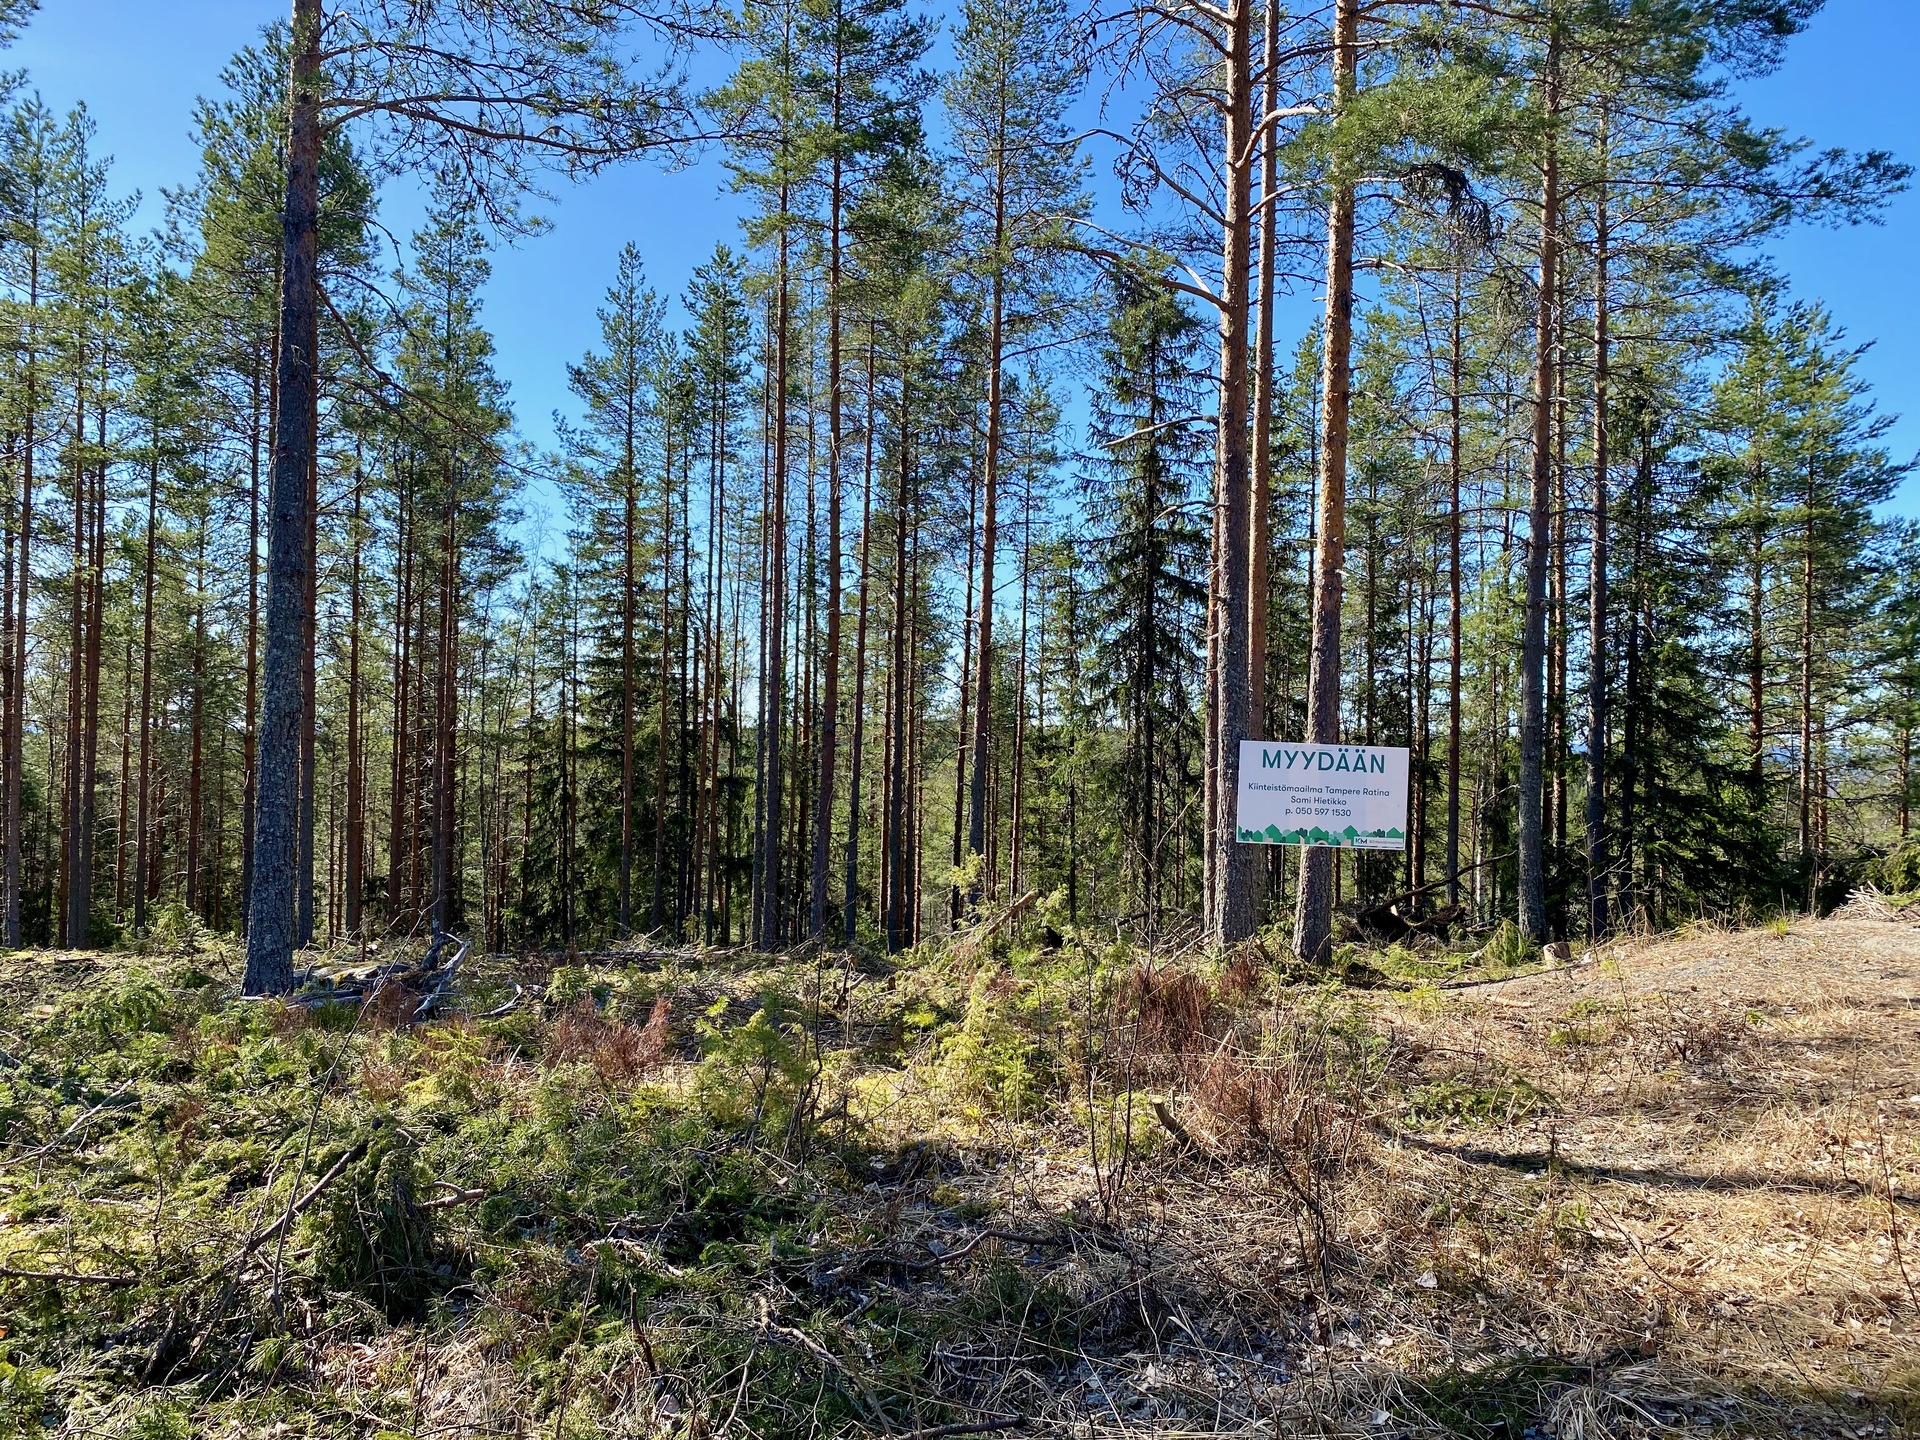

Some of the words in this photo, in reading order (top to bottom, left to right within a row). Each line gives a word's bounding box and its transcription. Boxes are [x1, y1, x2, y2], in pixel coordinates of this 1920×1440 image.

[1262, 748, 1385, 773] MYYDÄÄN
[1248, 783, 1323, 794] Kiinteistömaailma
[1325, 786, 1361, 796] Tampere
[1362, 788, 1390, 797] Ratina
[1290, 796, 1312, 804] Sami
[1313, 797, 1347, 806] Hietikko
[1285, 808, 1293, 816] p.
[1295, 807, 1313, 815] 050
[1314, 808, 1330, 816] 597
[1331, 809, 1352, 817] 1530
[1355, 837, 1368, 845] KM
